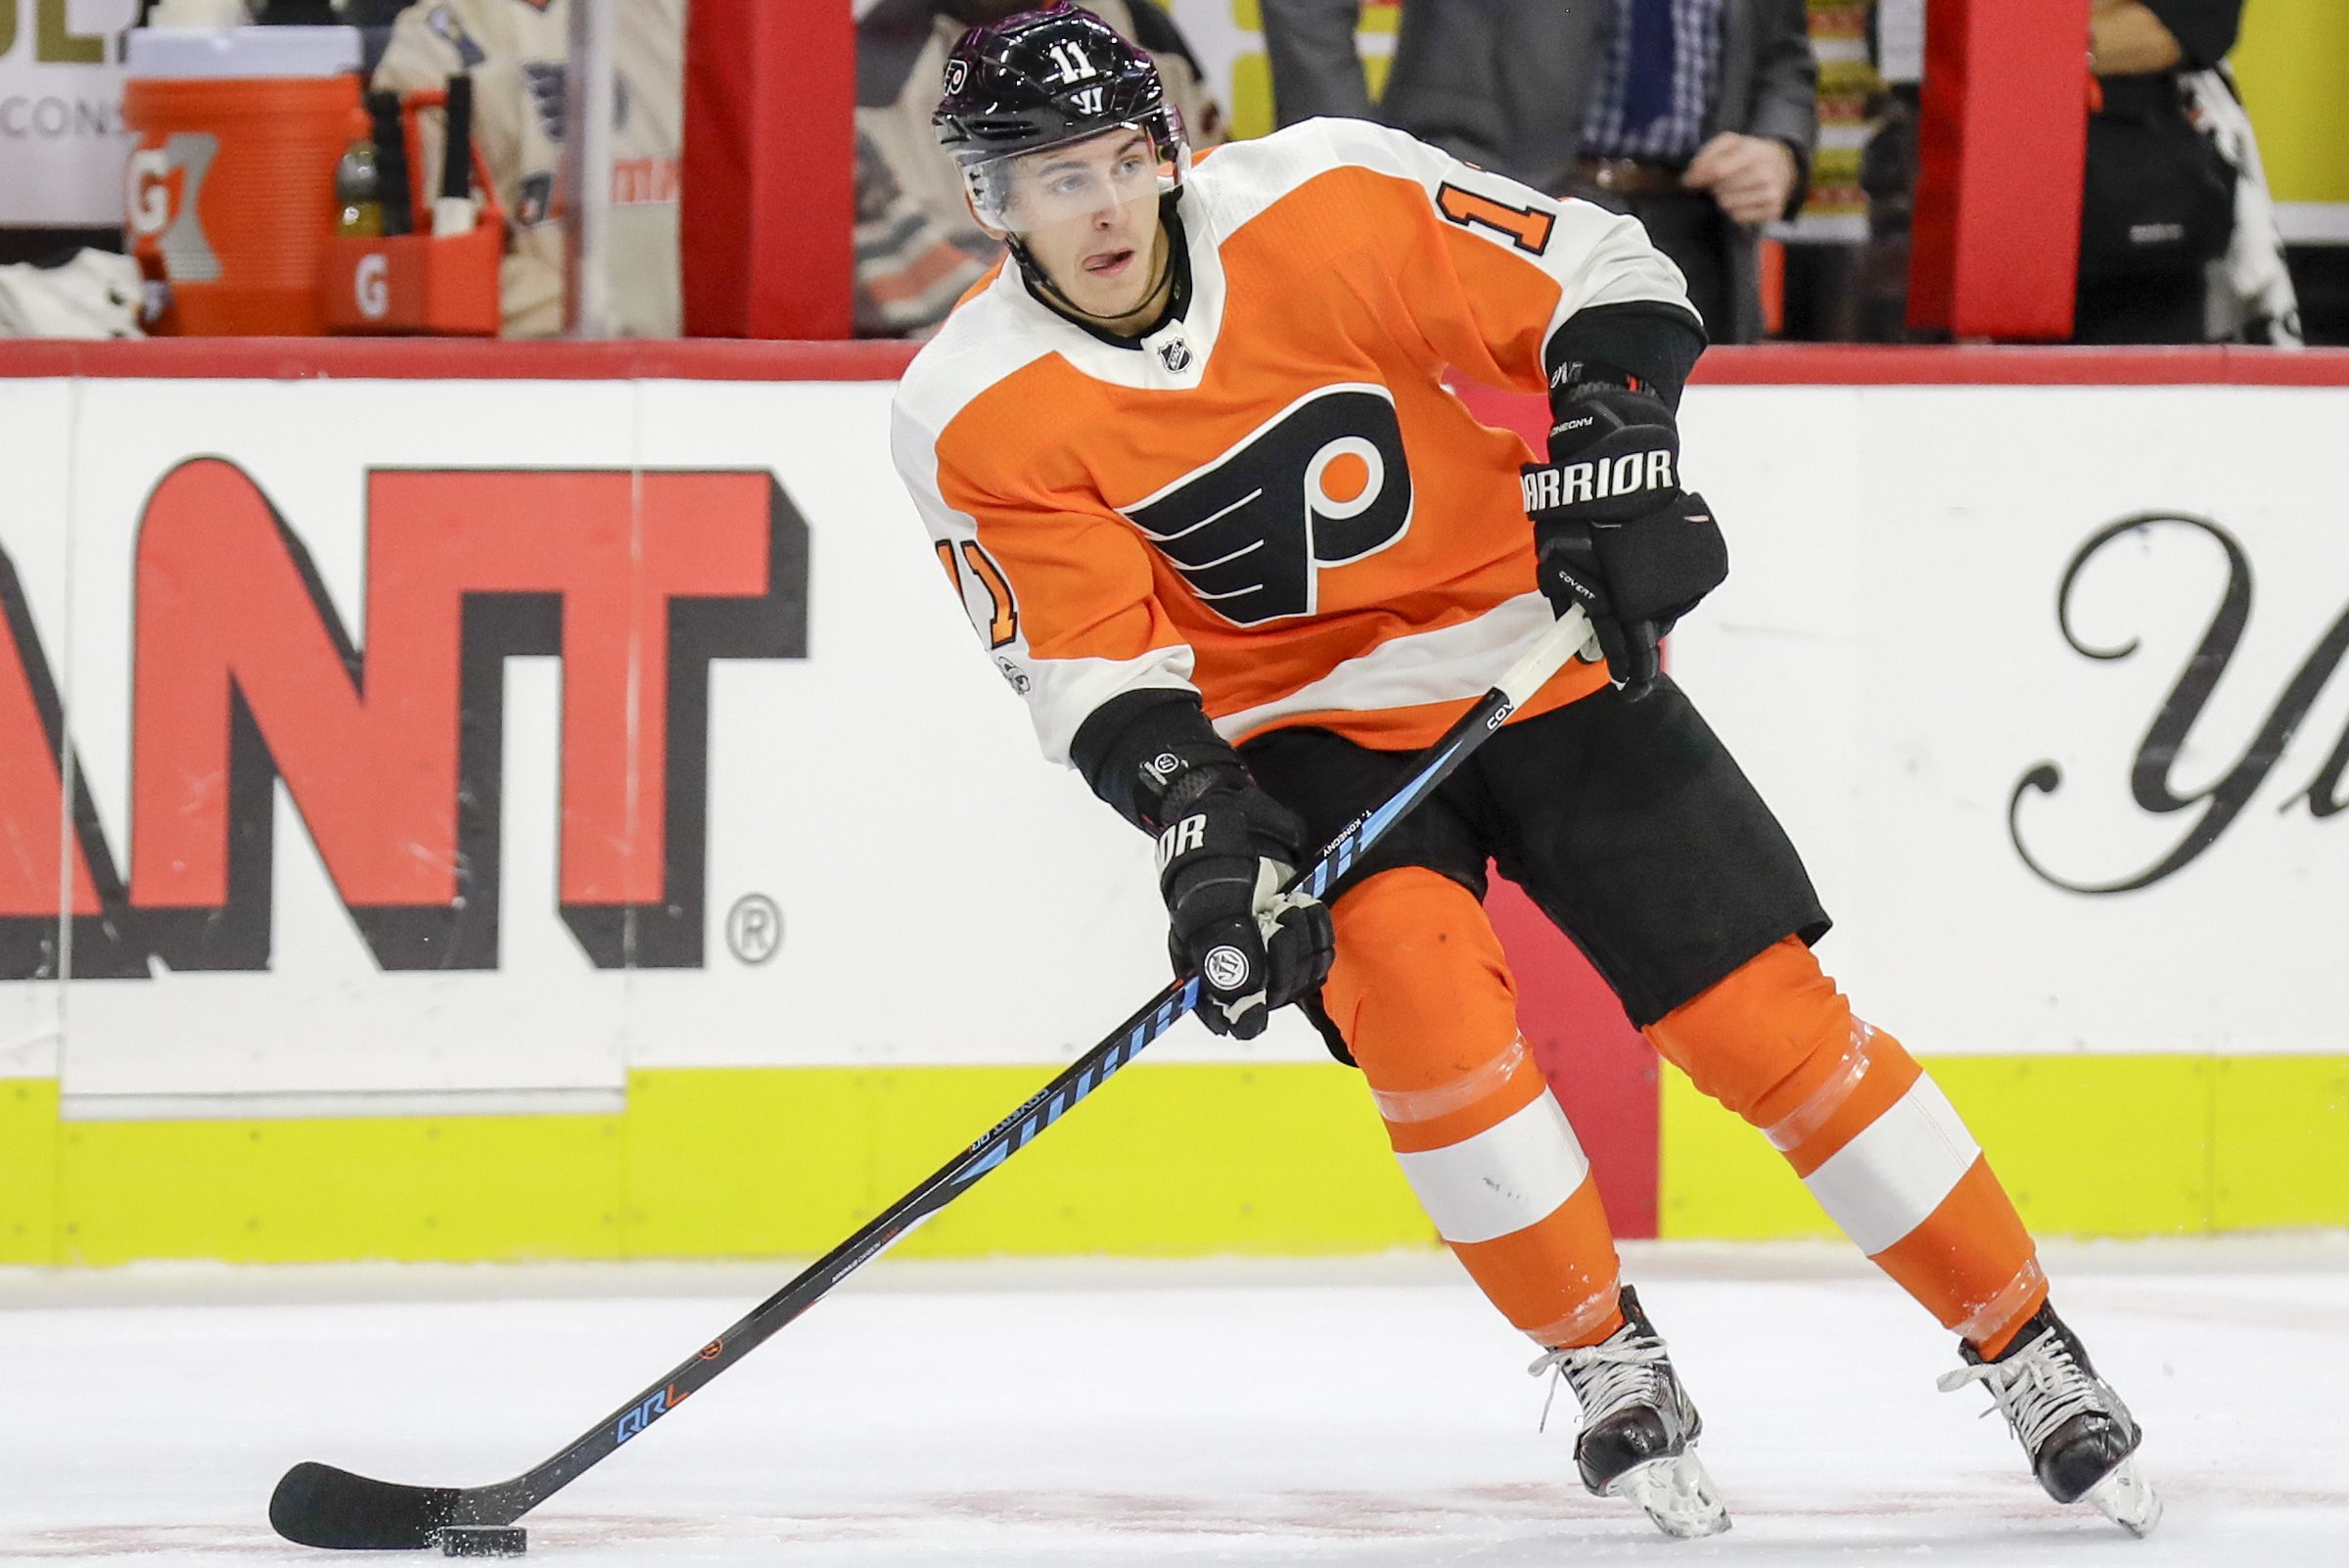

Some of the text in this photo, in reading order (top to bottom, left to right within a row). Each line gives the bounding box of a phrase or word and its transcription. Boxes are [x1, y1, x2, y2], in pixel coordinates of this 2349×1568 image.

[1050, 41, 1096, 84] 11
[0, 96, 125, 137] CON
[127, 148, 169, 233] G
[1436, 162, 1572, 256] 1
[354, 253, 389, 319] G
[1520, 449, 1674, 513] ARRIOR
[1155, 813, 1208, 877] OR
[1323, 818, 1361, 857] KONECNY
